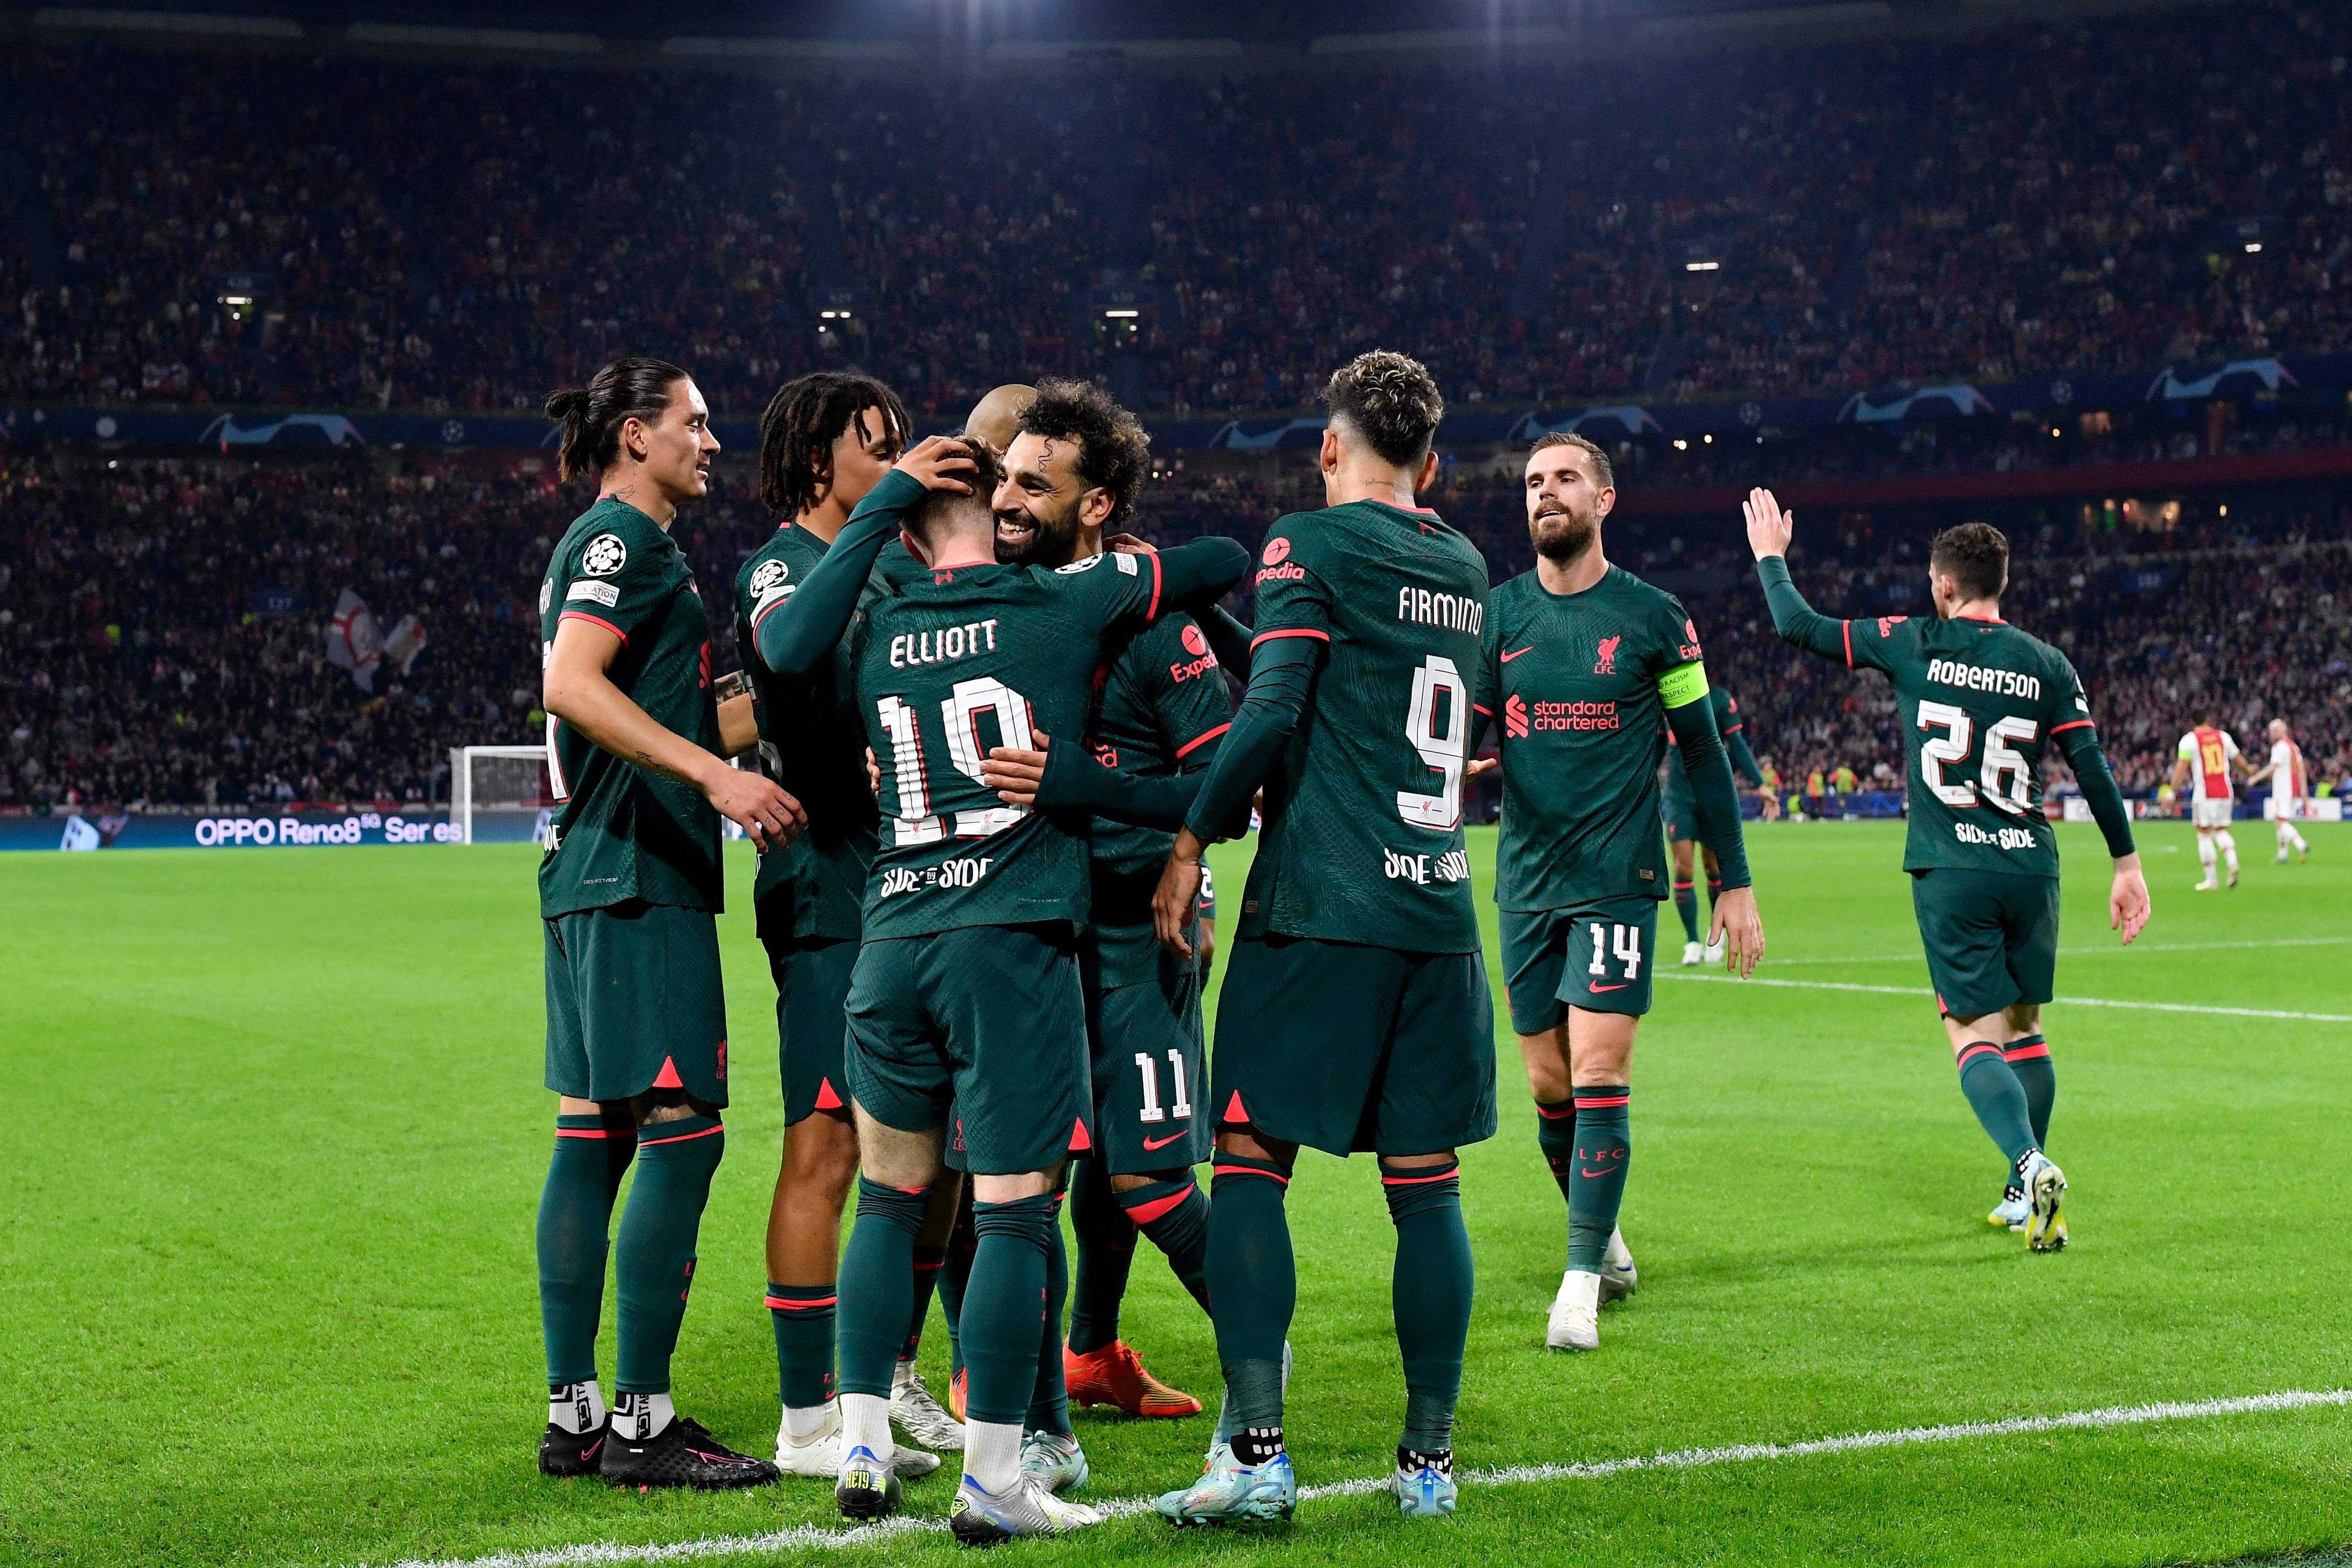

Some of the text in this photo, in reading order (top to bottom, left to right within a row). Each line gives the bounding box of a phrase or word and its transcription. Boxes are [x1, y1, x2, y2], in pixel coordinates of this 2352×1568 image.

[1255, 561, 1306, 587] pedia
[1398, 586, 1483, 637] FIRMINO
[890, 619, 998, 669] ELLIOTT
[1594, 665, 1616, 675] LFC
[1664, 672, 1689, 686] RACISM
[1927, 659, 2040, 701] ROBERTSON
[1533, 699, 1615, 716] standard
[1534, 713, 1619, 731] chartered
[1397, 654, 1467, 832] 9
[1917, 699, 2039, 816] 26
[877, 676, 1035, 846] 19
[195, 818, 275, 846] OPPO
[279, 817, 362, 844] Reno8
[385, 816, 464, 842] Seres
[1998, 828, 2037, 850] SIDE
[926, 870, 937, 882] BY
[1588, 922, 1642, 980] 14
[1135, 1048, 1192, 1124] 11
[846, 1470, 870, 1489] HE19
